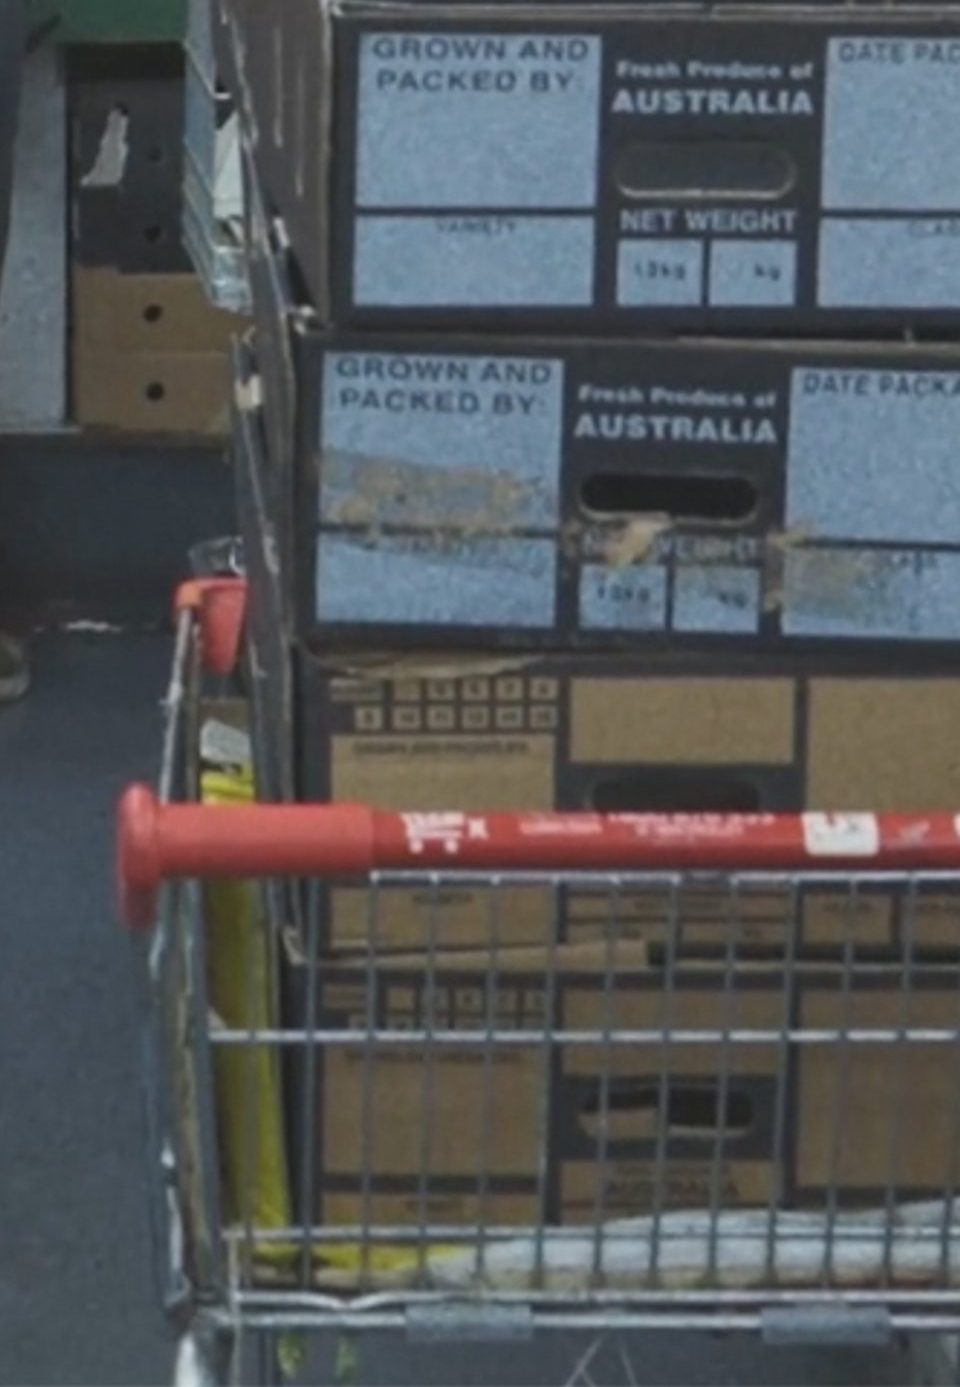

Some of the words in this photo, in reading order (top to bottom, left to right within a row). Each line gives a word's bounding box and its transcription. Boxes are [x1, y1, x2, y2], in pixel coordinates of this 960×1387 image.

[371, 36, 507, 61] GROWN
[517, 38, 589, 63] AND
[837, 41, 906, 65] DATE
[375, 68, 518, 93] PACKED
[616, 59, 682, 79] Fresh
[687, 60, 782, 80] Produce
[789, 62, 814, 80] of
[611, 88, 814, 115] AUSTRALIA
[619, 208, 674, 233] NET
[684, 208, 799, 233] WEIGHT
[335, 355, 470, 382] GROWN
[480, 361, 553, 386] AND
[577, 383, 645, 405] Fresh
[650, 386, 747, 408] Produce
[752, 389, 777, 408] of
[803, 373, 872, 396] DATE
[339, 386, 481, 414] PACKED
[573, 412, 778, 444] AUSTRALIA
